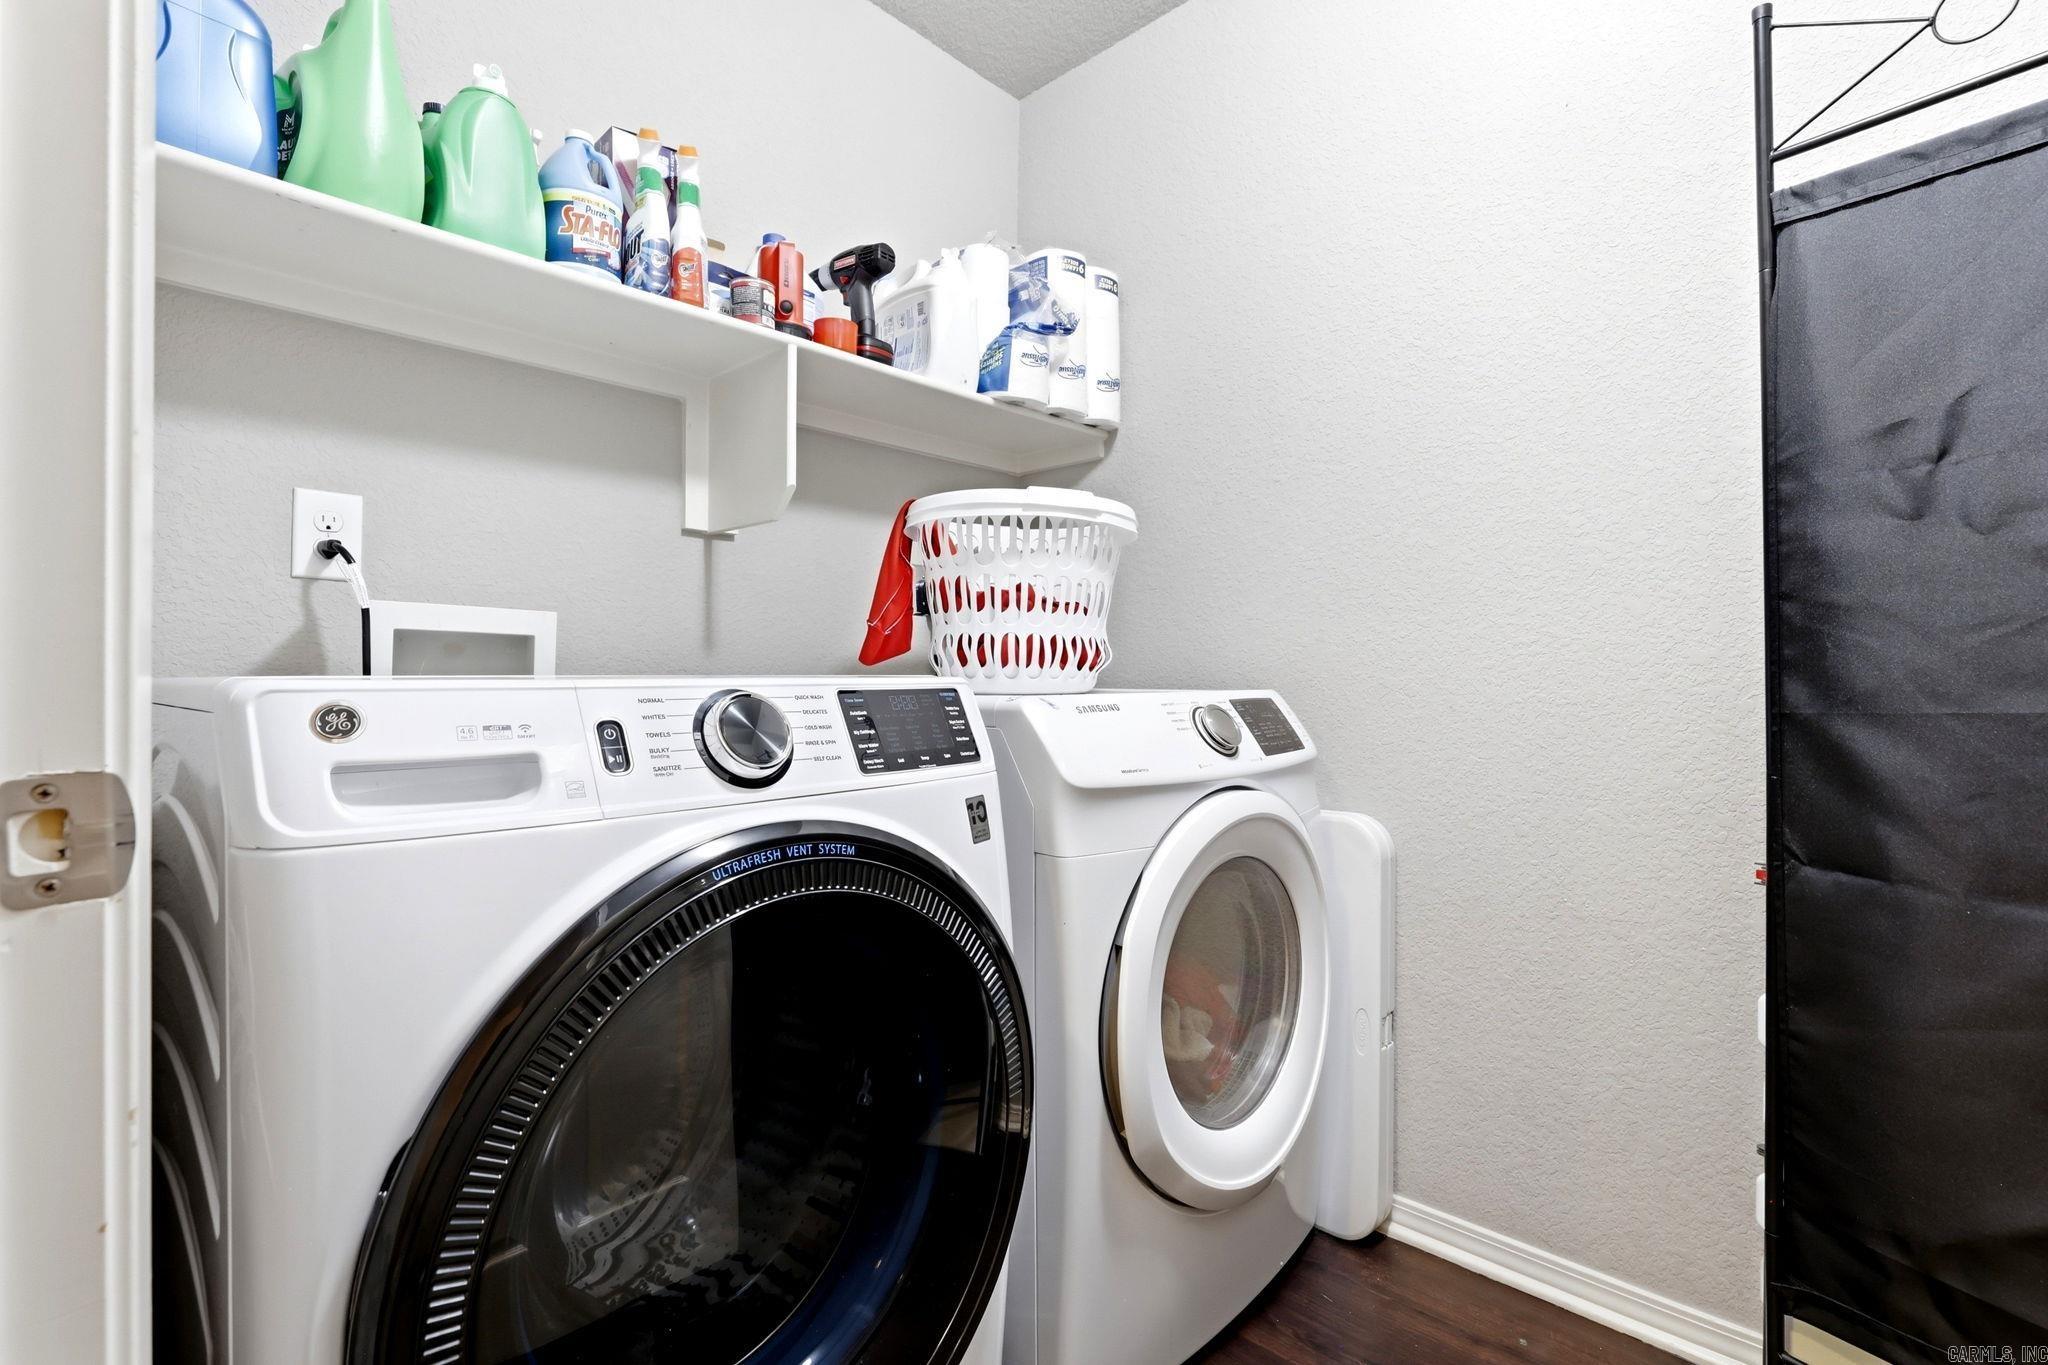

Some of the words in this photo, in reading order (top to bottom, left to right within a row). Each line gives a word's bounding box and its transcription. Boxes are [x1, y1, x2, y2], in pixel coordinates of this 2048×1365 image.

[585, 205, 607, 219] Purex
[559, 205, 621, 250] STA-FLO
[1075, 703, 1121, 714] SAMSUNG
[653, 764, 682, 772] SANITIZE
[712, 849, 781, 881] ULTRAFRESH
[786, 844, 812, 858] VENT
[818, 843, 855, 856] SYSTEM
